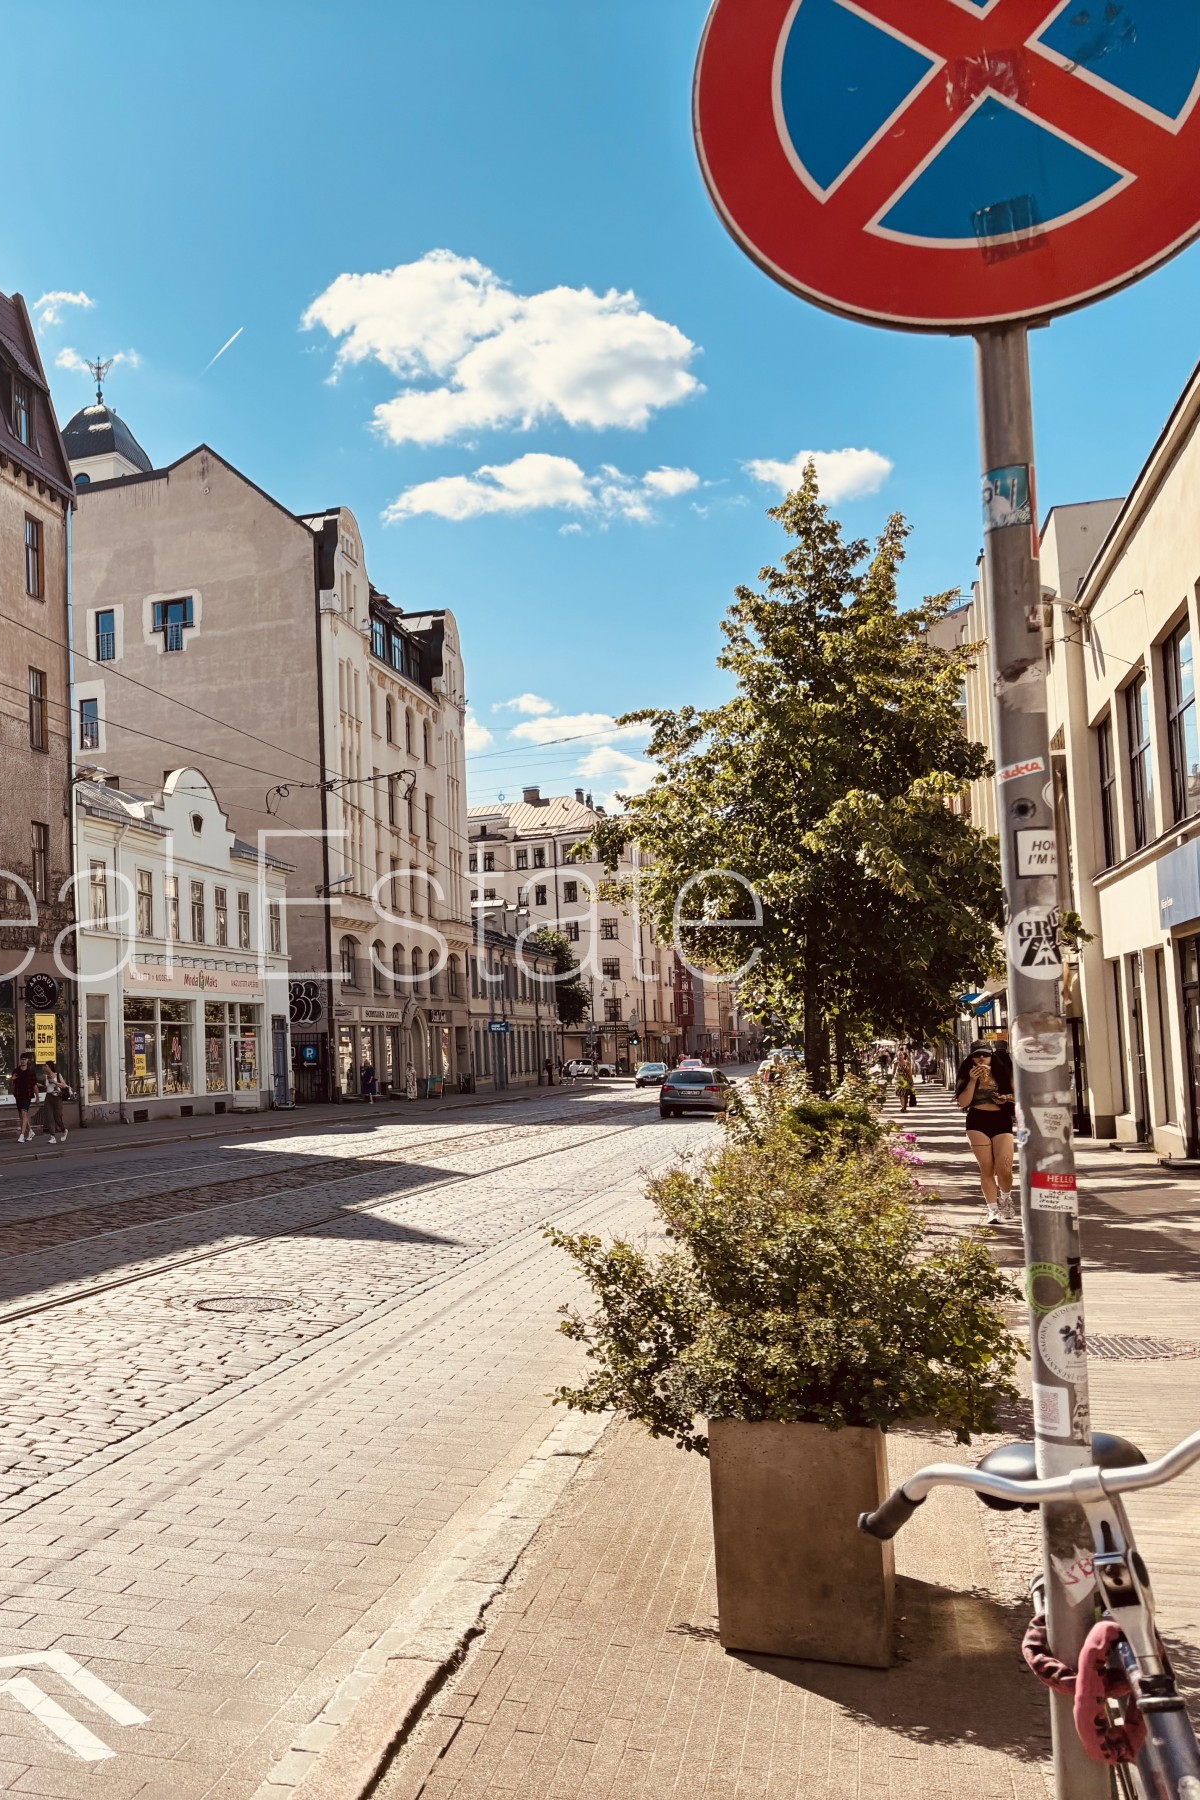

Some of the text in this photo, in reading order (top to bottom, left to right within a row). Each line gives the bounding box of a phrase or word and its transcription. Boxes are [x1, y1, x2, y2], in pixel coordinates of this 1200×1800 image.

[29, 974, 54, 988] AROMUS
[184, 973, 198, 987] Moda
[204, 974, 218, 988] Maks
[37, 1033, 46, 1044] 55
[1047, 1174, 1074, 1184] HELLO
